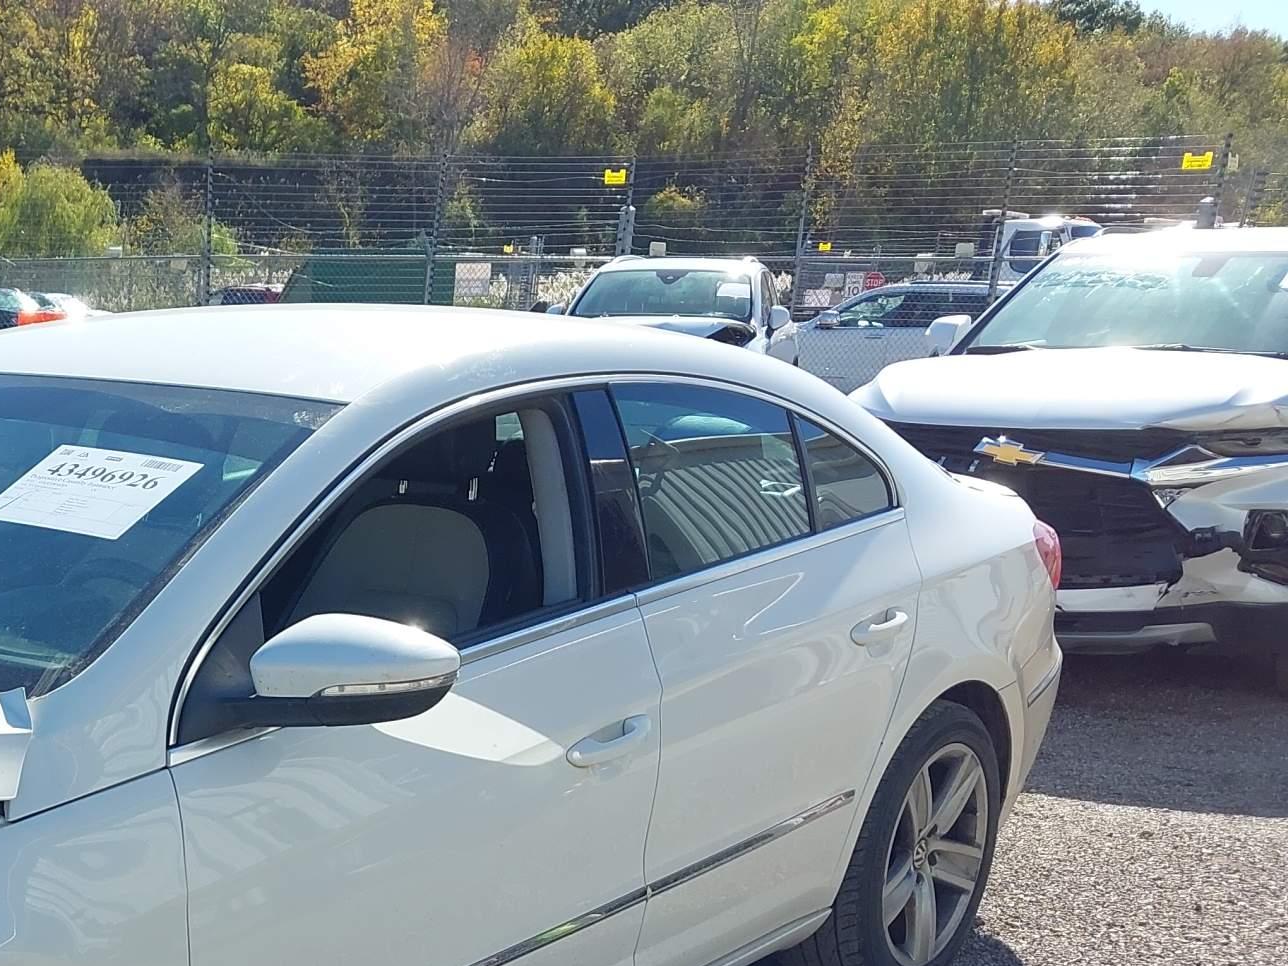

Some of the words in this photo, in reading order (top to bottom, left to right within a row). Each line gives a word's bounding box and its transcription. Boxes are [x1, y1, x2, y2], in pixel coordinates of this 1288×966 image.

[866, 279, 883, 287] STOP
[847, 286, 859, 296] 10
[47, 462, 168, 490] 43496926
